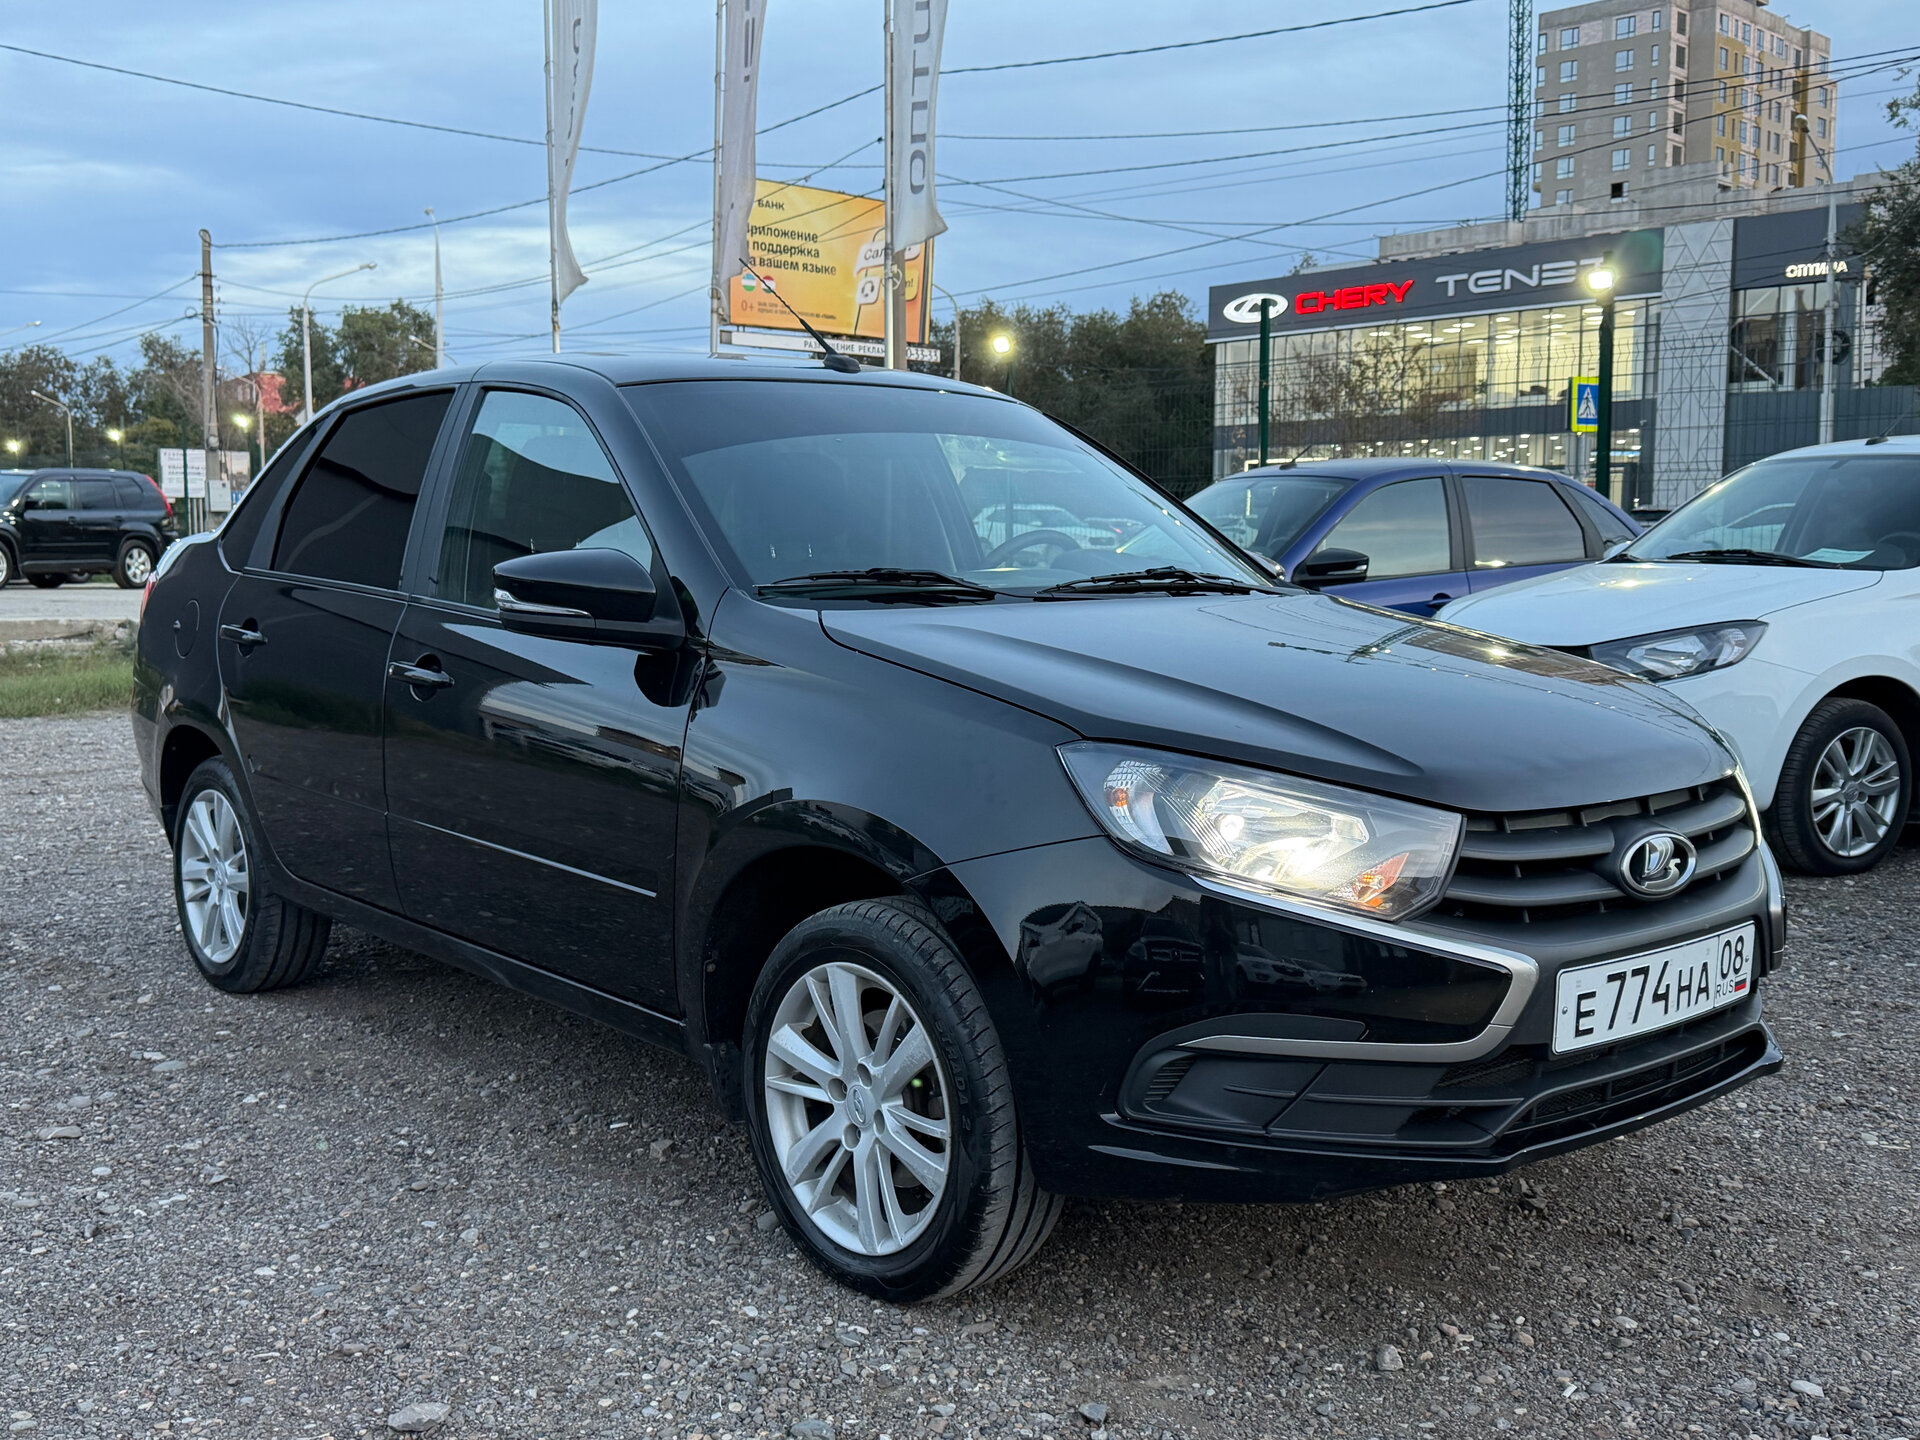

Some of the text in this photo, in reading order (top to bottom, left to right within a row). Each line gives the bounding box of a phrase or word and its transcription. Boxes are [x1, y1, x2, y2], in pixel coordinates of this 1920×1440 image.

[757, 200, 785, 211] БАНК
[752, 241, 820, 258] поддержка
[760, 256, 800, 272] вашем
[802, 262, 837, 275] языке
[1295, 280, 1414, 314] CHERY
[803, 341, 855, 352] РАЗЩЕНИЕ
[1720, 935, 1745, 980] 08
[1716, 980, 1735, 1000] RUS
